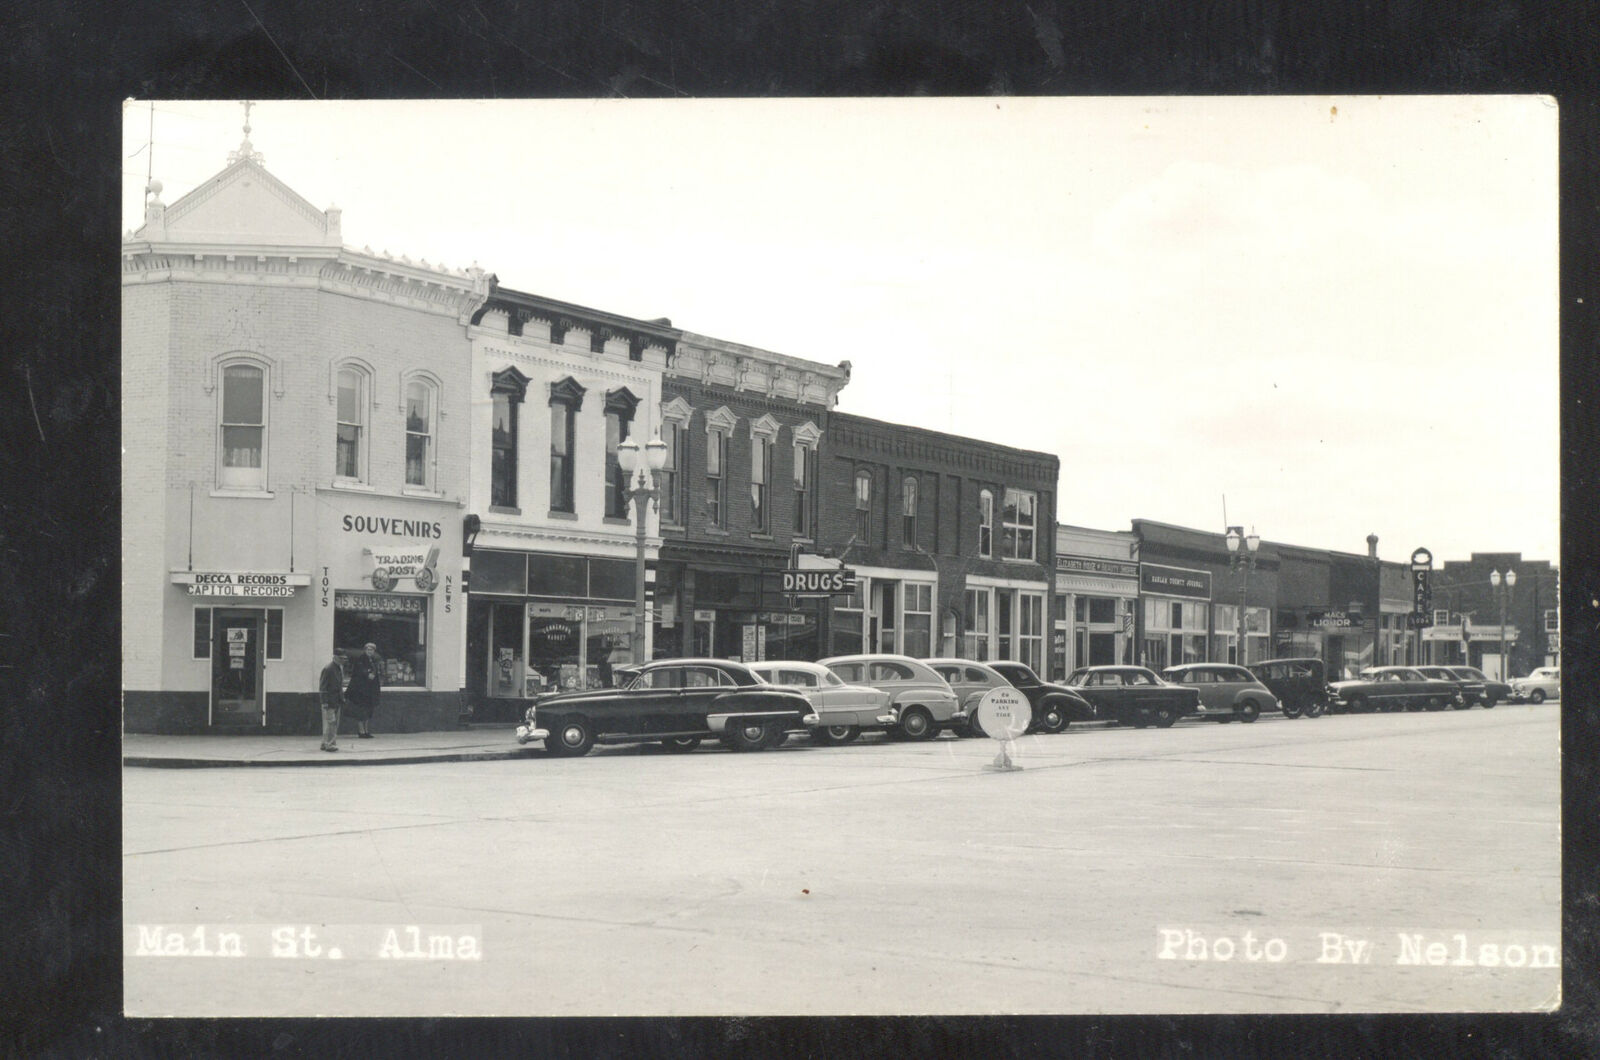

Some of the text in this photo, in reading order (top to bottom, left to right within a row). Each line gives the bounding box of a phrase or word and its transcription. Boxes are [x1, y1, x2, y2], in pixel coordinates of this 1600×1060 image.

[342, 514, 442, 539] SOUVENIRS
[375, 555, 424, 564] TRADING
[388, 565, 416, 576] POST
[195, 574, 287, 584] DECCA RECORDS
[783, 573, 844, 591] DRUGS
[187, 585, 295, 596] CAPITOL RECORDS
[321, 566, 330, 607] TOYS
[1416, 571, 1425, 613] CAFE
[445, 575, 453, 613] NEWS
[1313, 619, 1351, 627] LIQUOR
